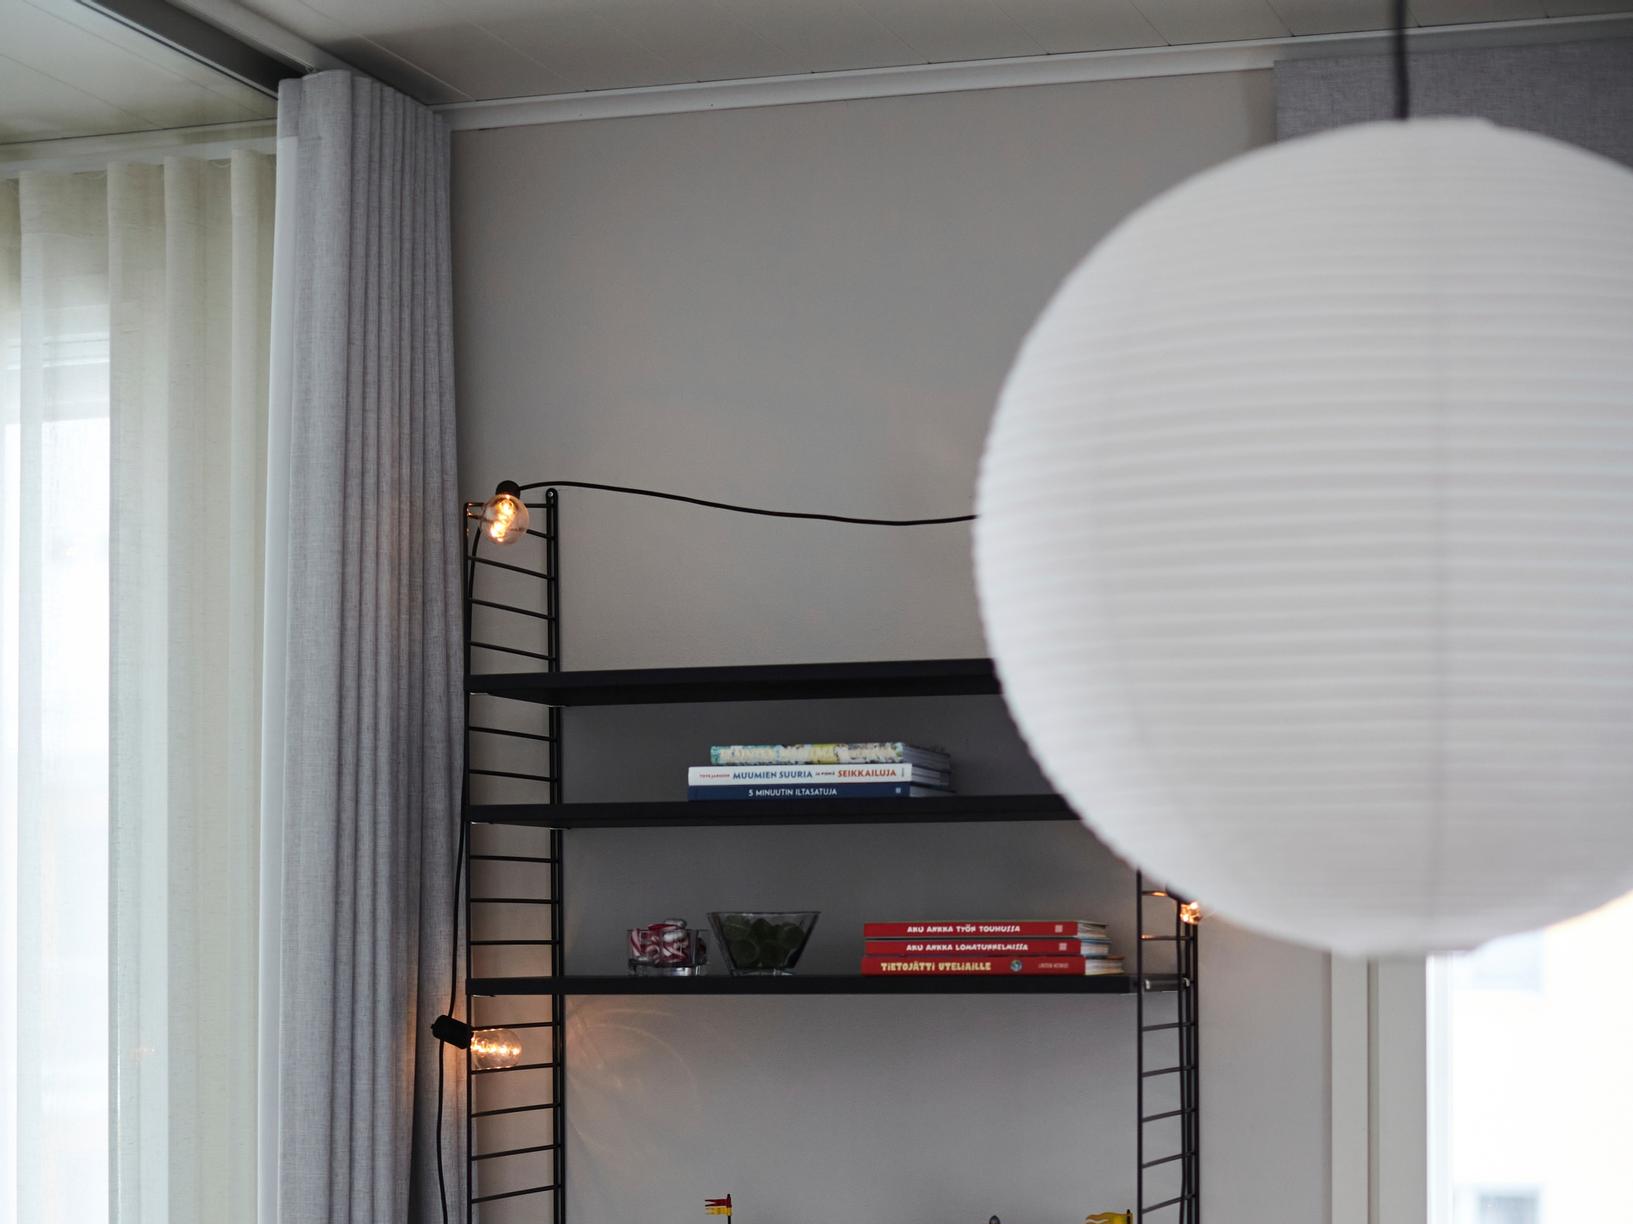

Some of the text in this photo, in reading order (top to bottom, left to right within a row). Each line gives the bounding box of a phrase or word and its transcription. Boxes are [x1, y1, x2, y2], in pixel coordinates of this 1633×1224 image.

[732, 771, 777, 780] MUUMIEN
[779, 770, 813, 779] SUURIA
[837, 769, 897, 778] SEIKKAILUJA
[748, 788, 838, 797] 5 MINUUTIN ILTASATUJA
[956, 924, 976, 933] TYÖN
[979, 925, 1021, 933] TOUHUSSA
[955, 943, 1029, 951] LOMATUNNELMISSA
